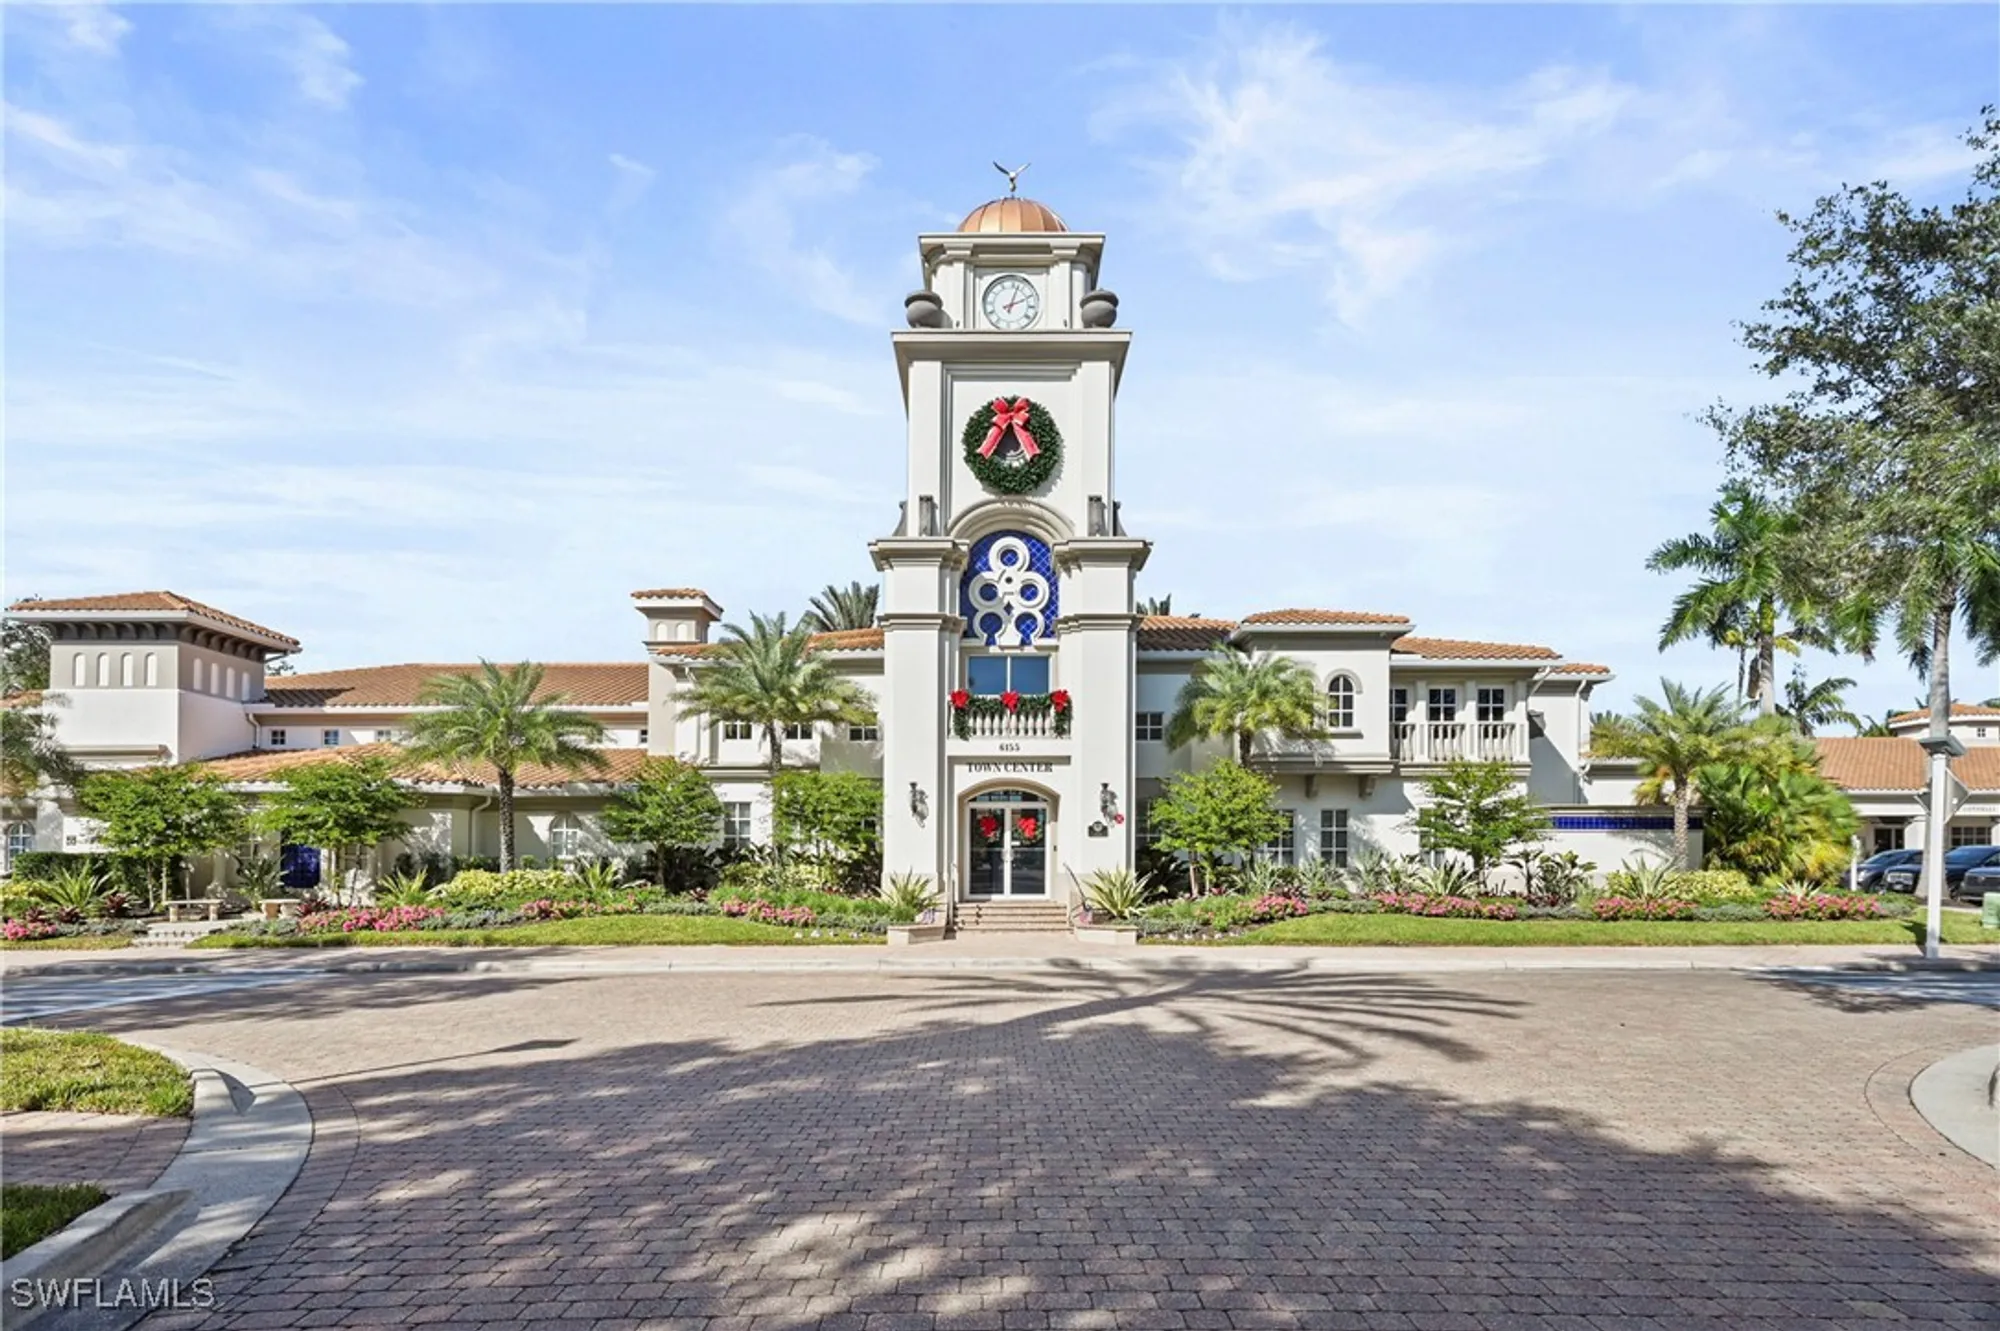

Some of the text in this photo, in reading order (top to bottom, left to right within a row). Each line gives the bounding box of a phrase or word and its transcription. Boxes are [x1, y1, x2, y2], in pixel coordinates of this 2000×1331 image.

[999, 743, 1020, 752] 6155
[967, 762, 1053, 773] TOWN CENTER
